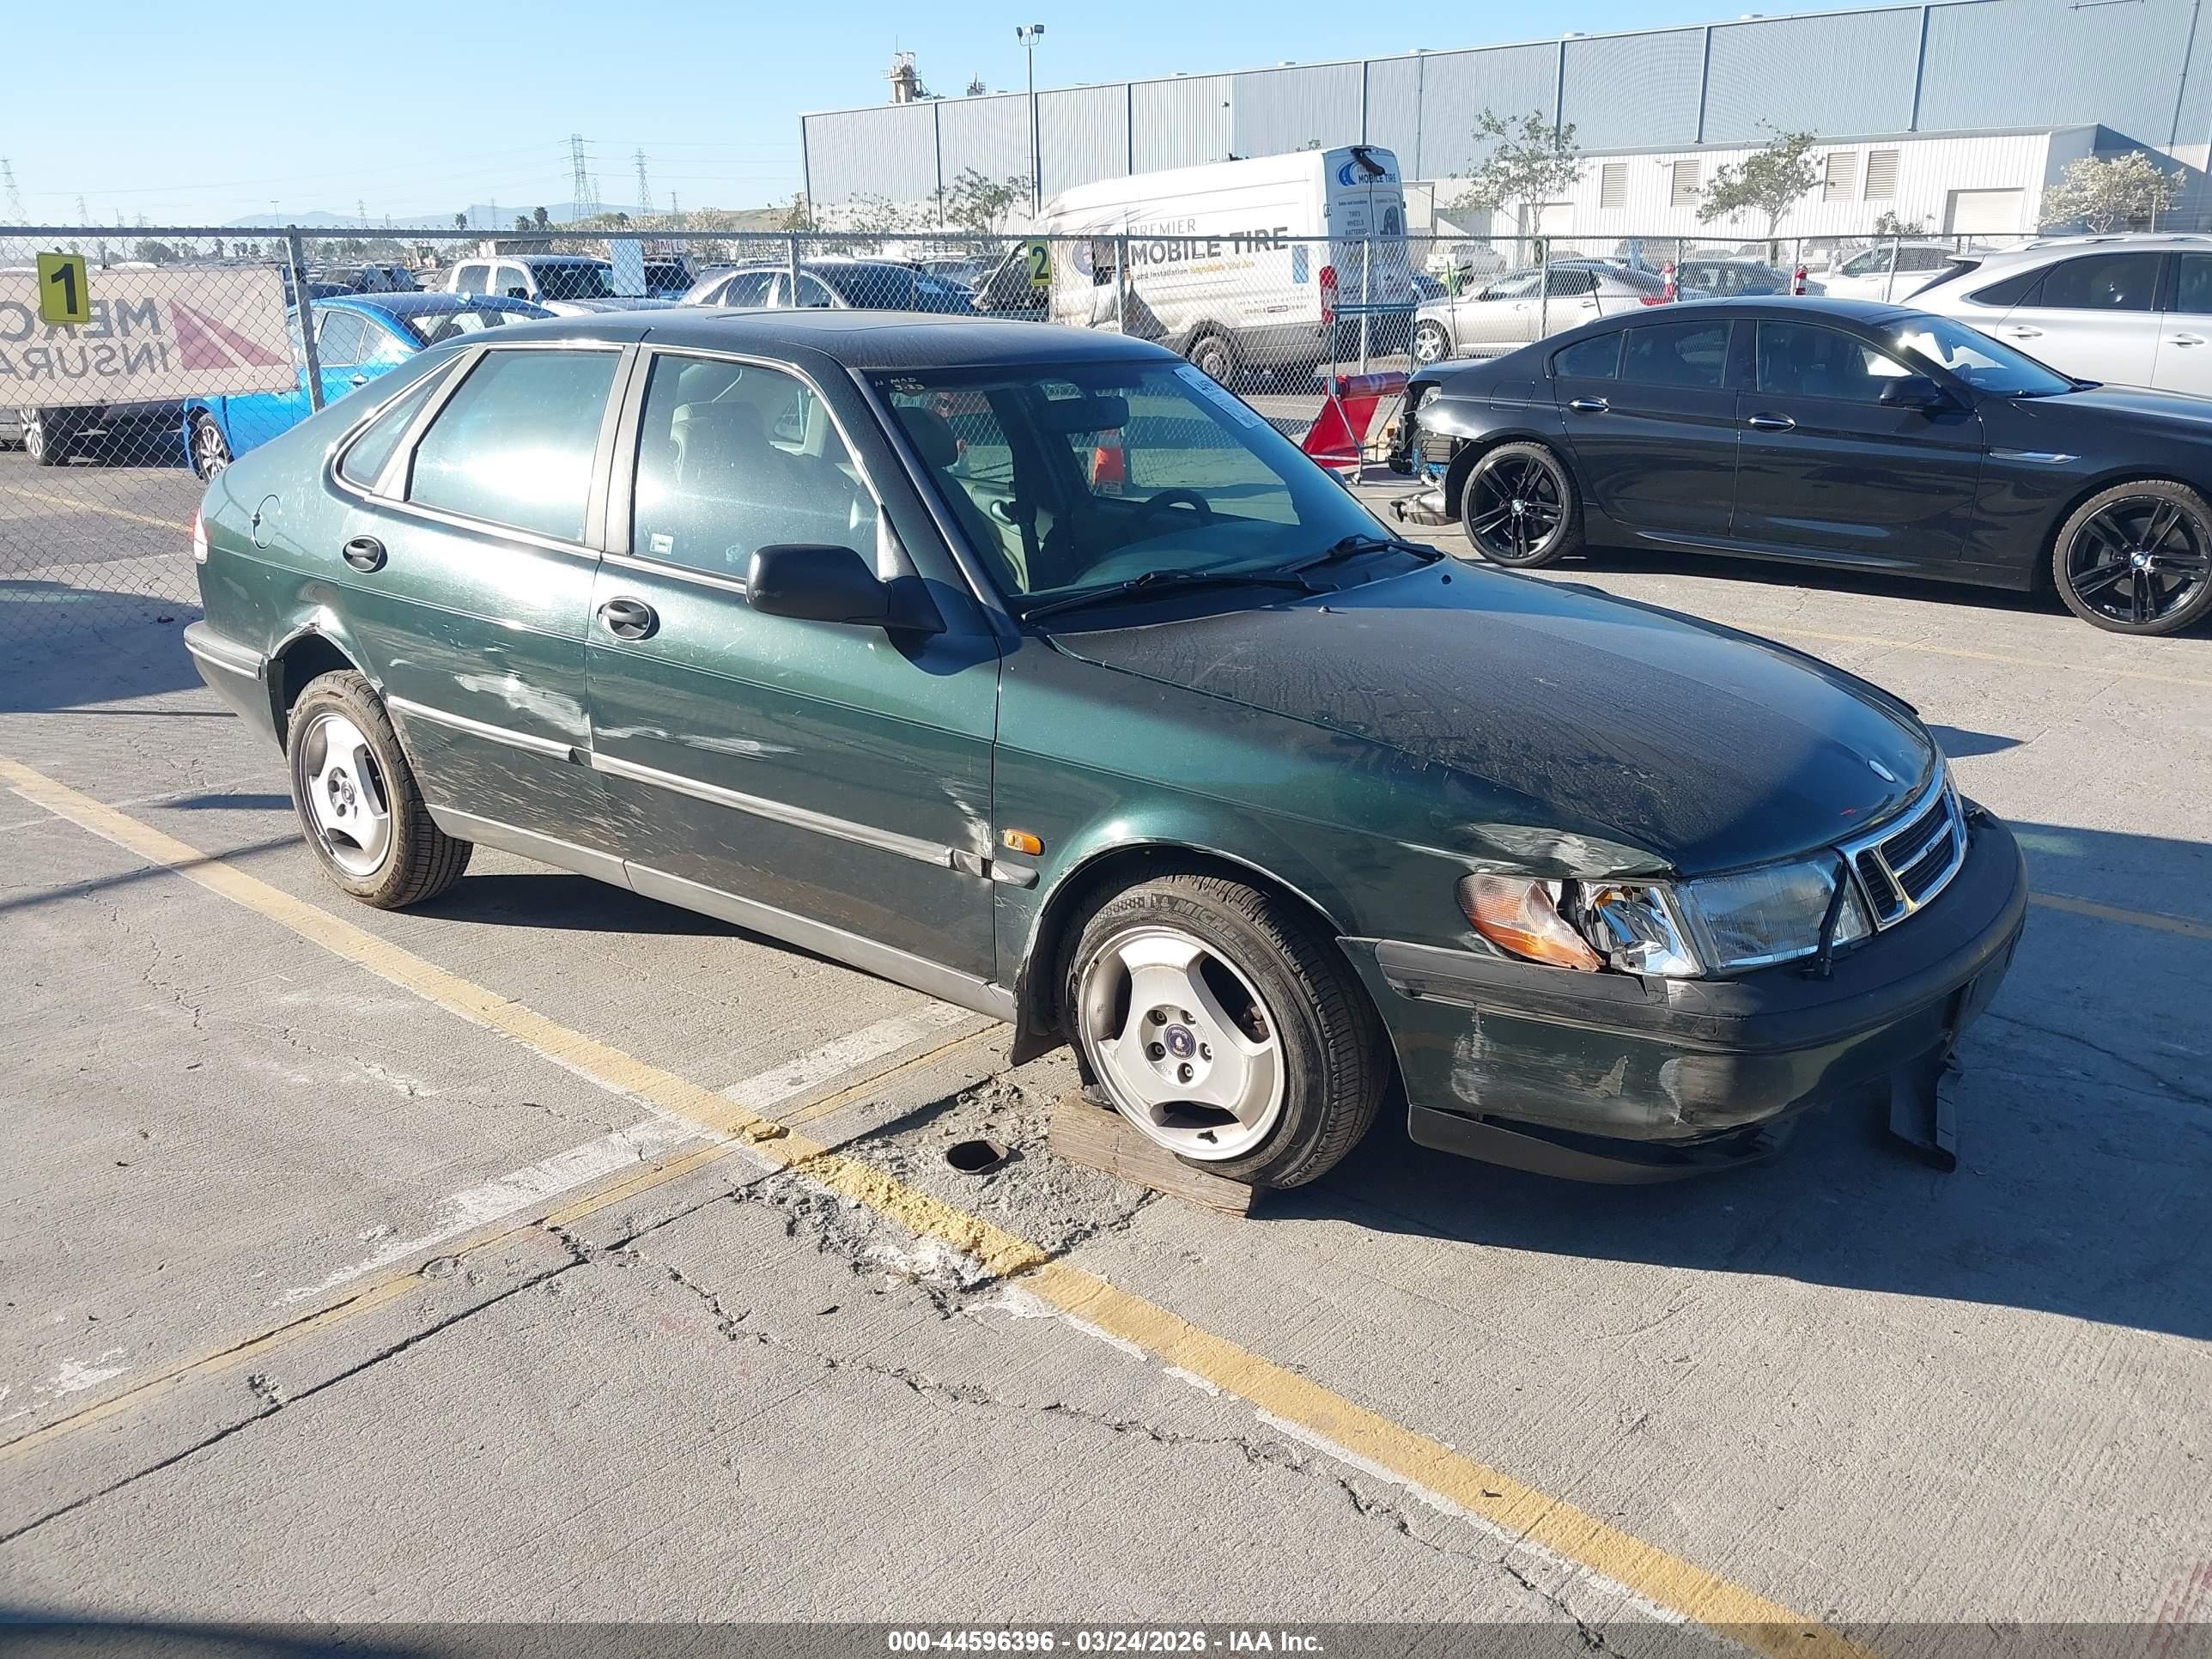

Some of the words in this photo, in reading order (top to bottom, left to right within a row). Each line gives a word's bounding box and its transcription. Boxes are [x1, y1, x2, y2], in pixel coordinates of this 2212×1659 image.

[1358, 173, 1383, 184] MOBILE
[1385, 173, 1396, 183] TIRE
[1129, 218, 1196, 239] PREMIER
[1130, 235, 1222, 266] MOBILE
[1229, 226, 1289, 255] TIRE
[1534, 240, 1543, 264] 3
[1770, 244, 1778, 264] 4
[1032, 246, 1048, 280] 2
[1151, 267, 1188, 279] Installation
[51, 263, 78, 315] 1
[1173, 899, 1271, 974] MICHELIN
